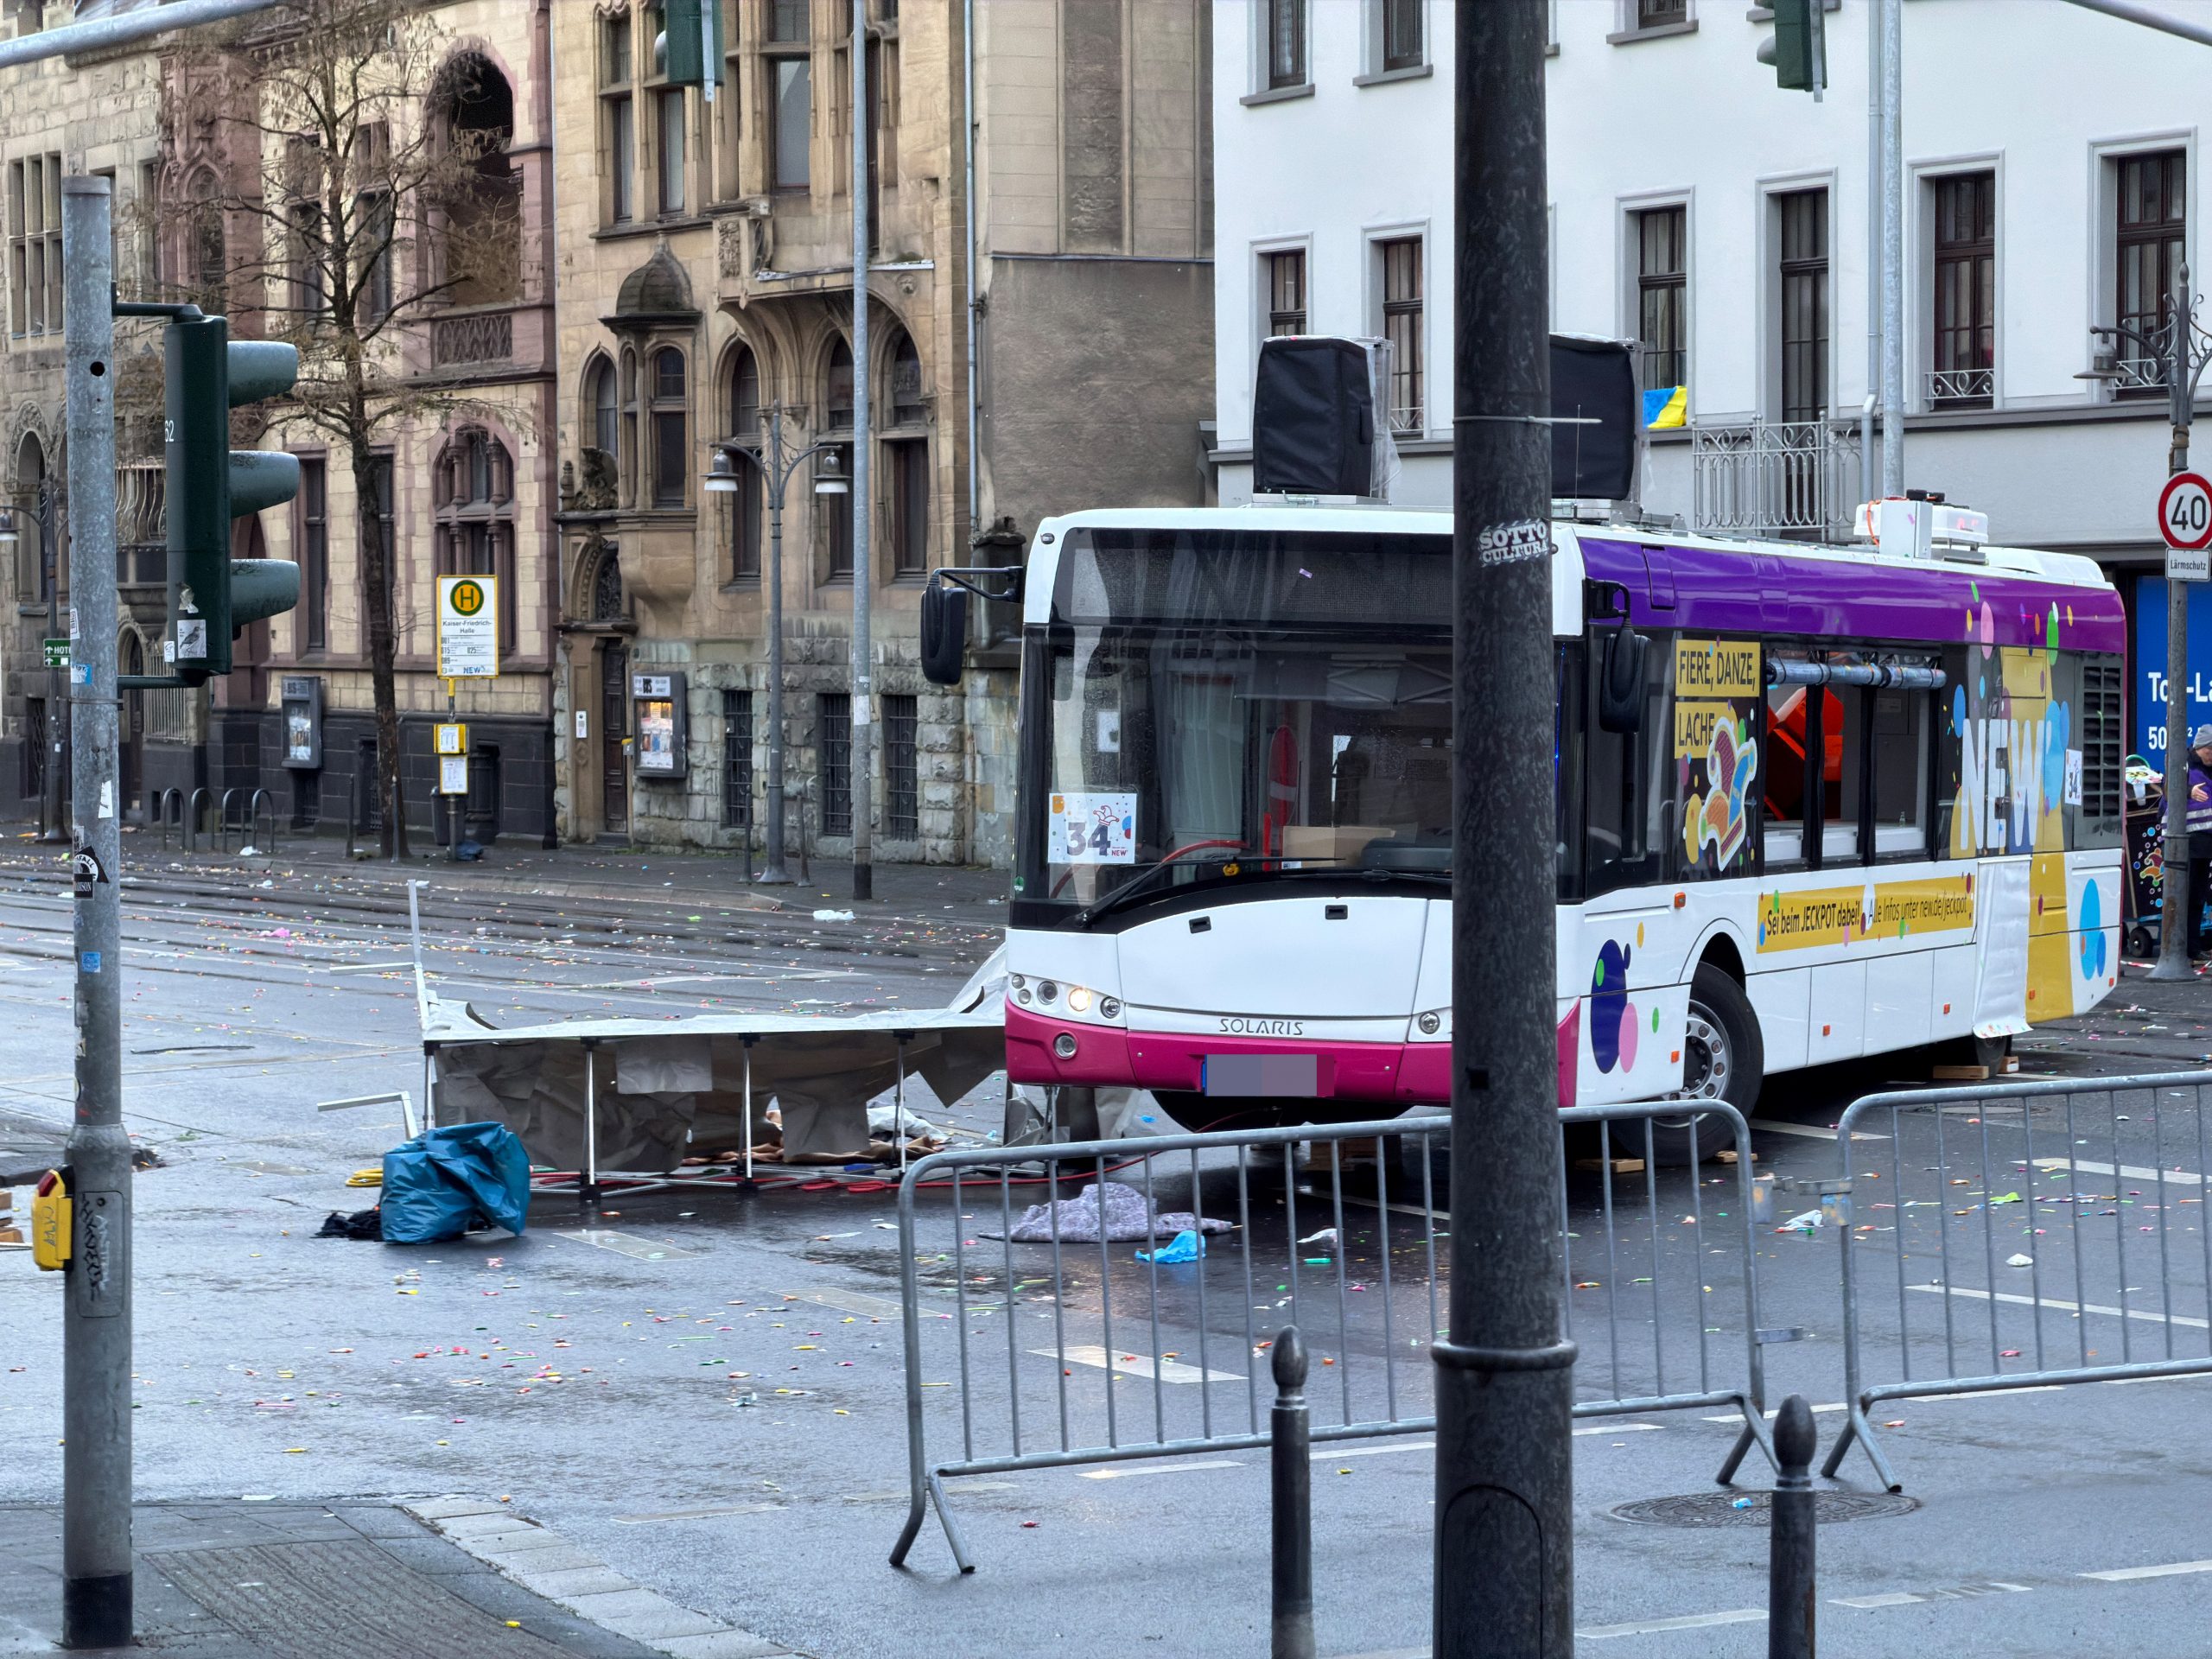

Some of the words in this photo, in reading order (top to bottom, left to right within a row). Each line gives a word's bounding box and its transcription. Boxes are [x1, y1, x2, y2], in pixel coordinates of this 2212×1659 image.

[2171, 495, 2206, 531] 40
[1478, 521, 1547, 550] SOTTO
[1483, 539, 1548, 563] CULTURA
[2170, 559, 2207, 570] Lärmschutz
[461, 588, 474, 607] H
[1680, 651, 1714, 692] FIERE,
[1716, 651, 1756, 692] DANZE,
[2069, 772, 2078, 799] 34
[1067, 822, 1111, 856] 34
[1767, 908, 1780, 936] Sei
[1781, 906, 1800, 934] beim
[1801, 903, 1837, 931] JECKPOT
[1837, 900, 1860, 927] dabei!
[1867, 896, 1882, 924] Alle
[1884, 897, 1900, 922] Infos
[1901, 899, 1919, 920] unter
[1920, 890, 1967, 921] new.de/jeckpot
[1219, 1018, 1304, 1036] SOLARIS
